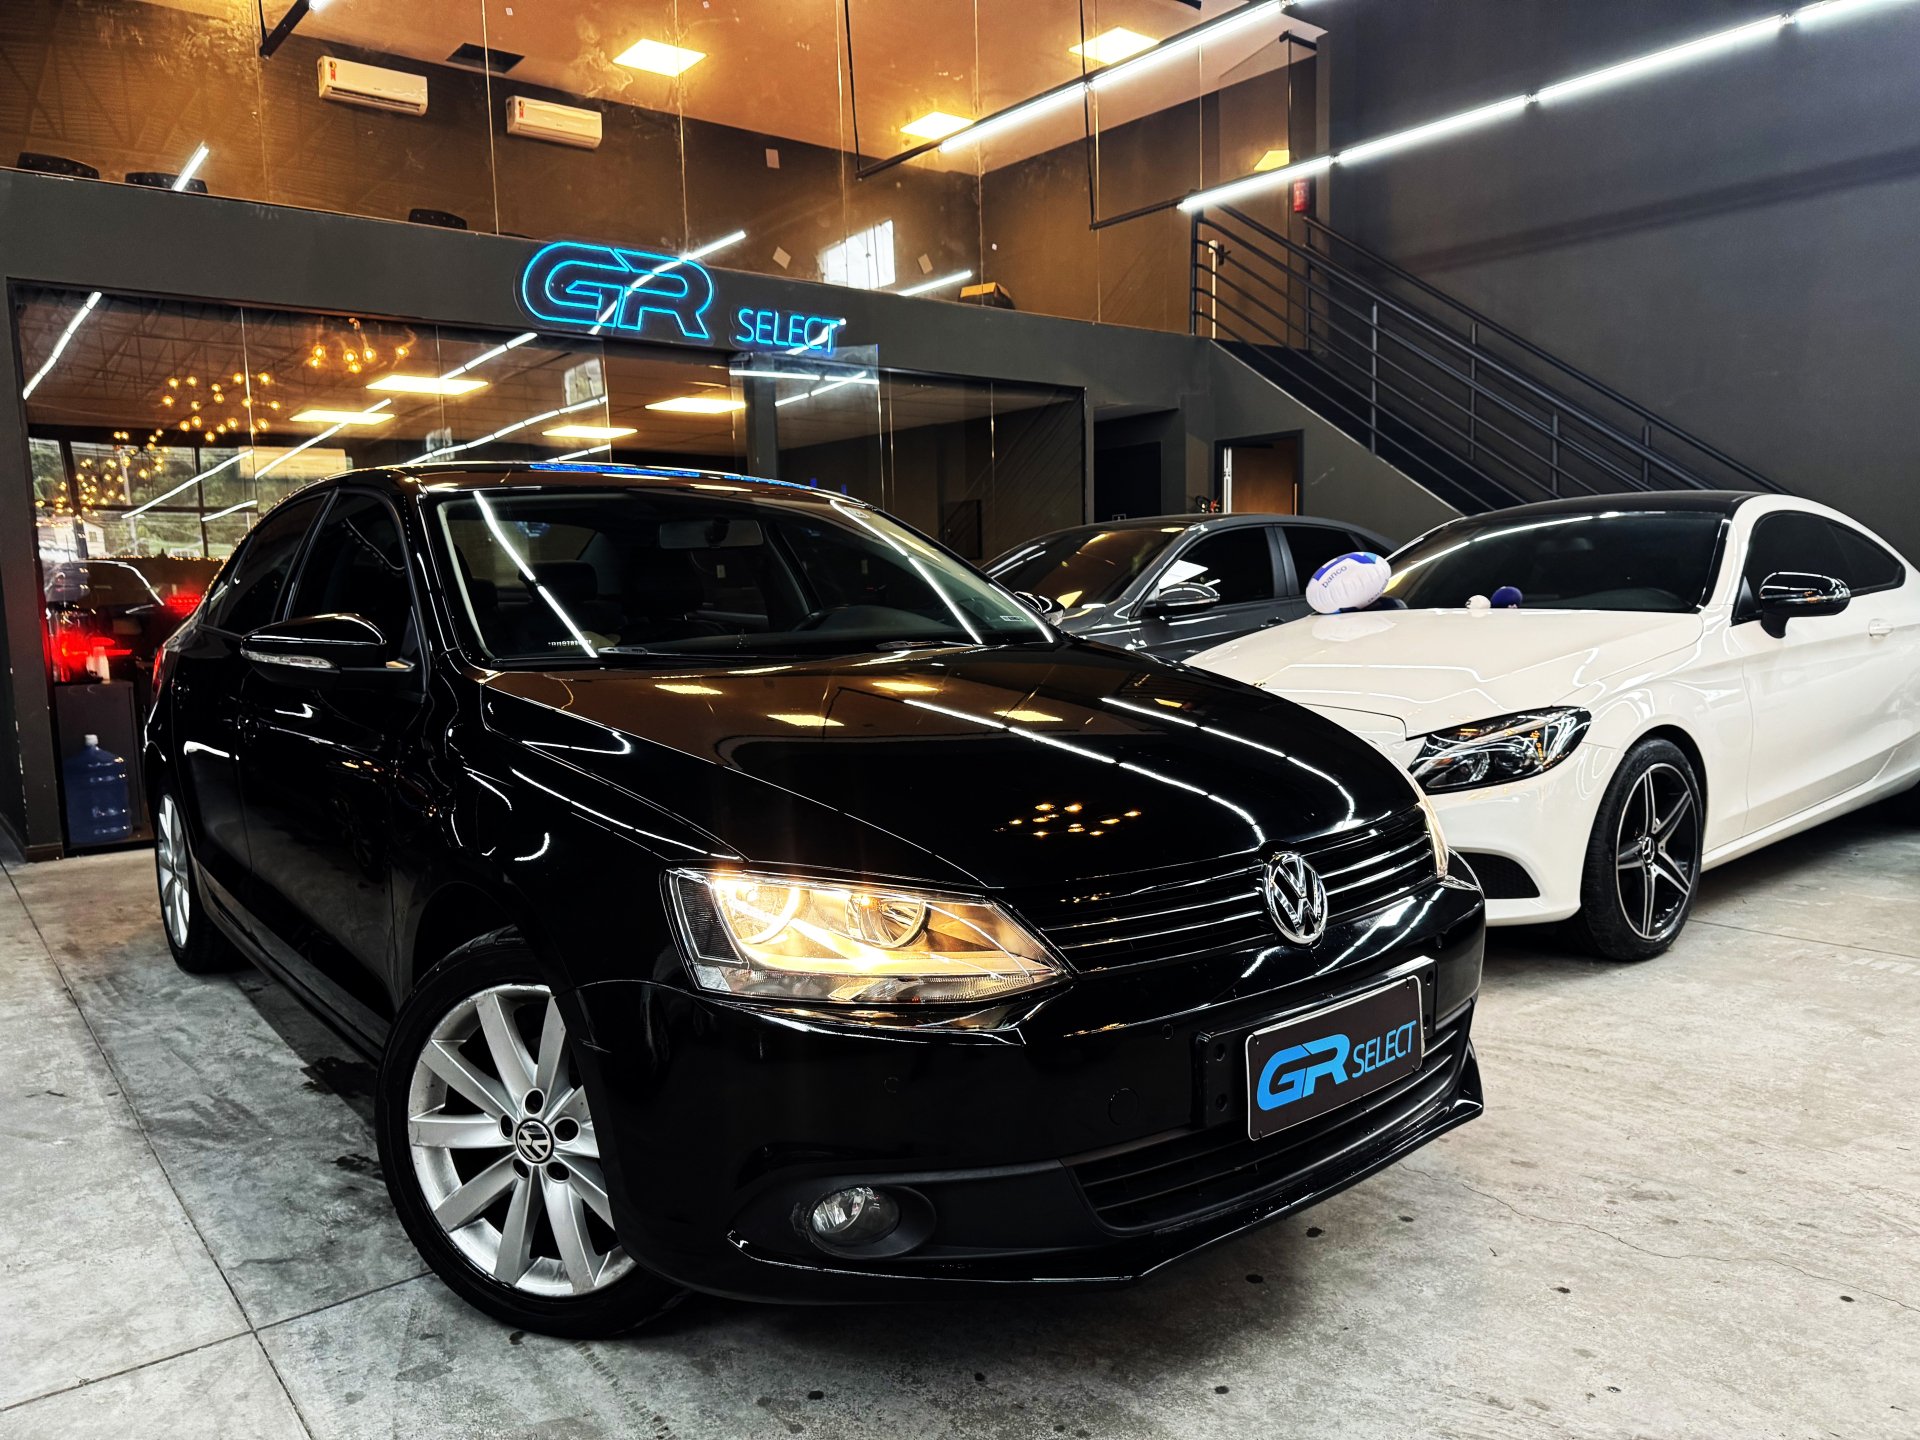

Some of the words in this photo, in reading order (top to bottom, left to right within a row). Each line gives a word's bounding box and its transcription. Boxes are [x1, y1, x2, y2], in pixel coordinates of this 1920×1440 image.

[522, 241, 714, 339] GR
[736, 308, 843, 354] SELECT
[1257, 1033, 1351, 1112] GR
[1352, 1020, 1417, 1079] SELECT
